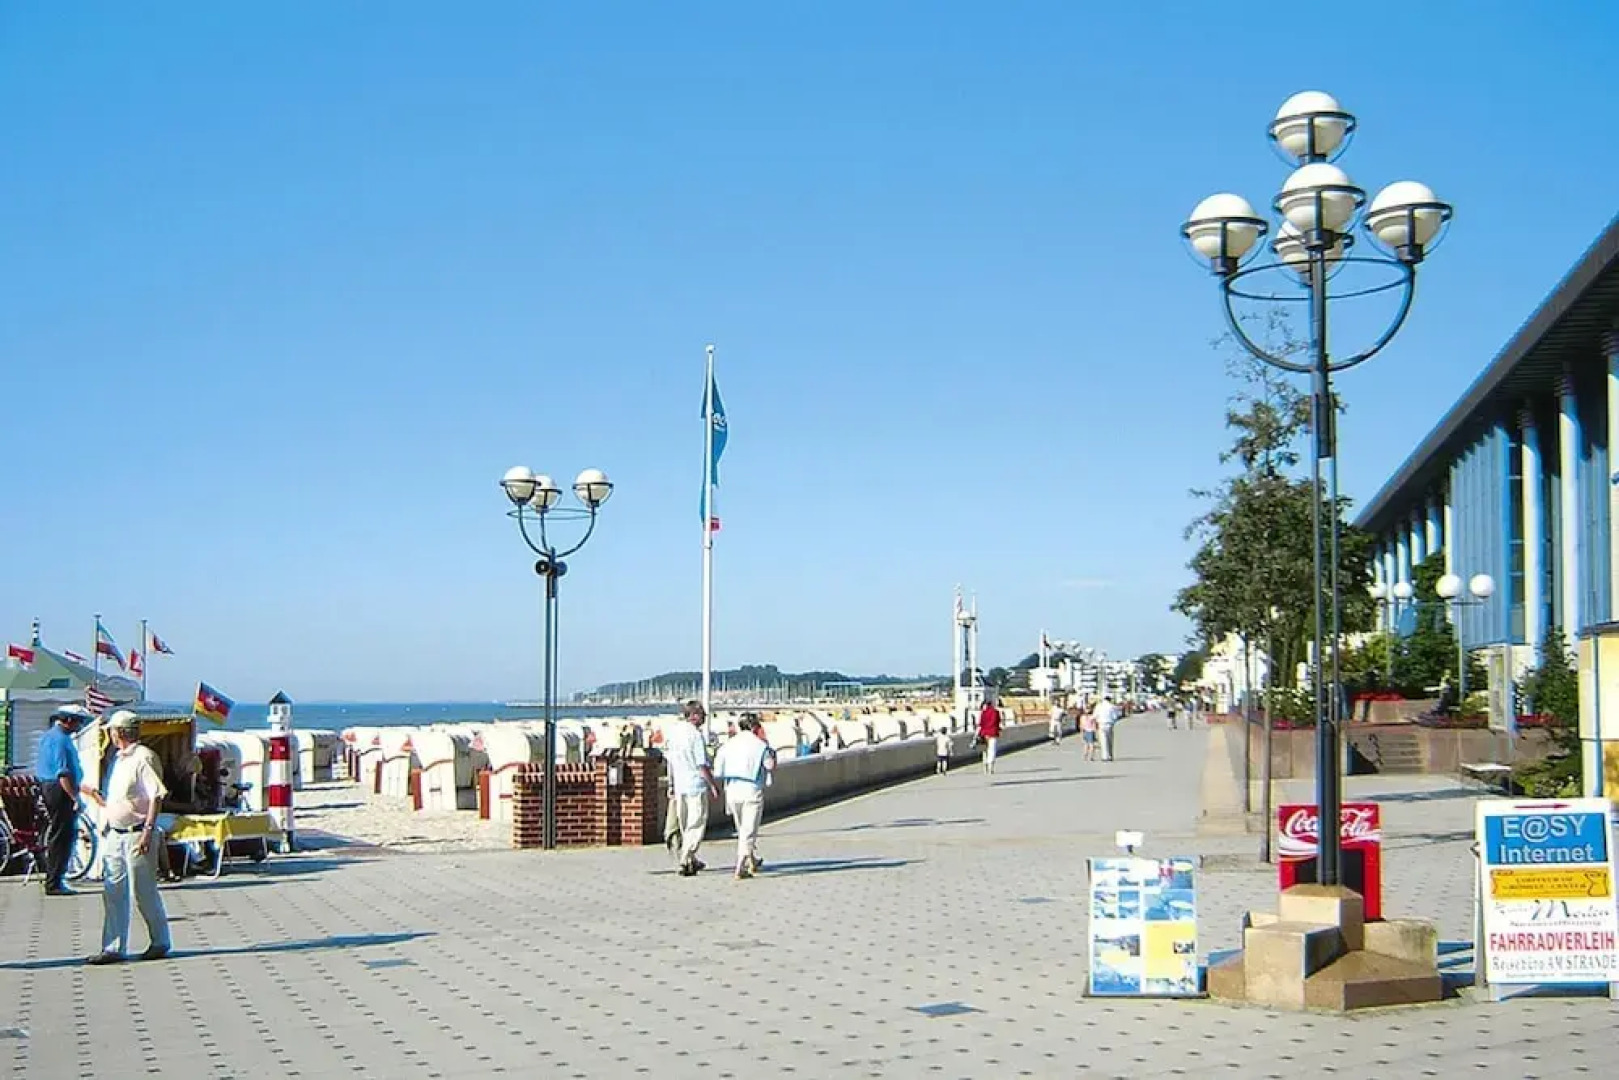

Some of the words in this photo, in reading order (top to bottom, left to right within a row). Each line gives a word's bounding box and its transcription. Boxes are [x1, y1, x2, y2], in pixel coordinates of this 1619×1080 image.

[1503, 815, 1587, 843] E@SY
[1500, 843, 1594, 863] Internet
[1490, 932, 1615, 951] FAHRRADVERLEIH
